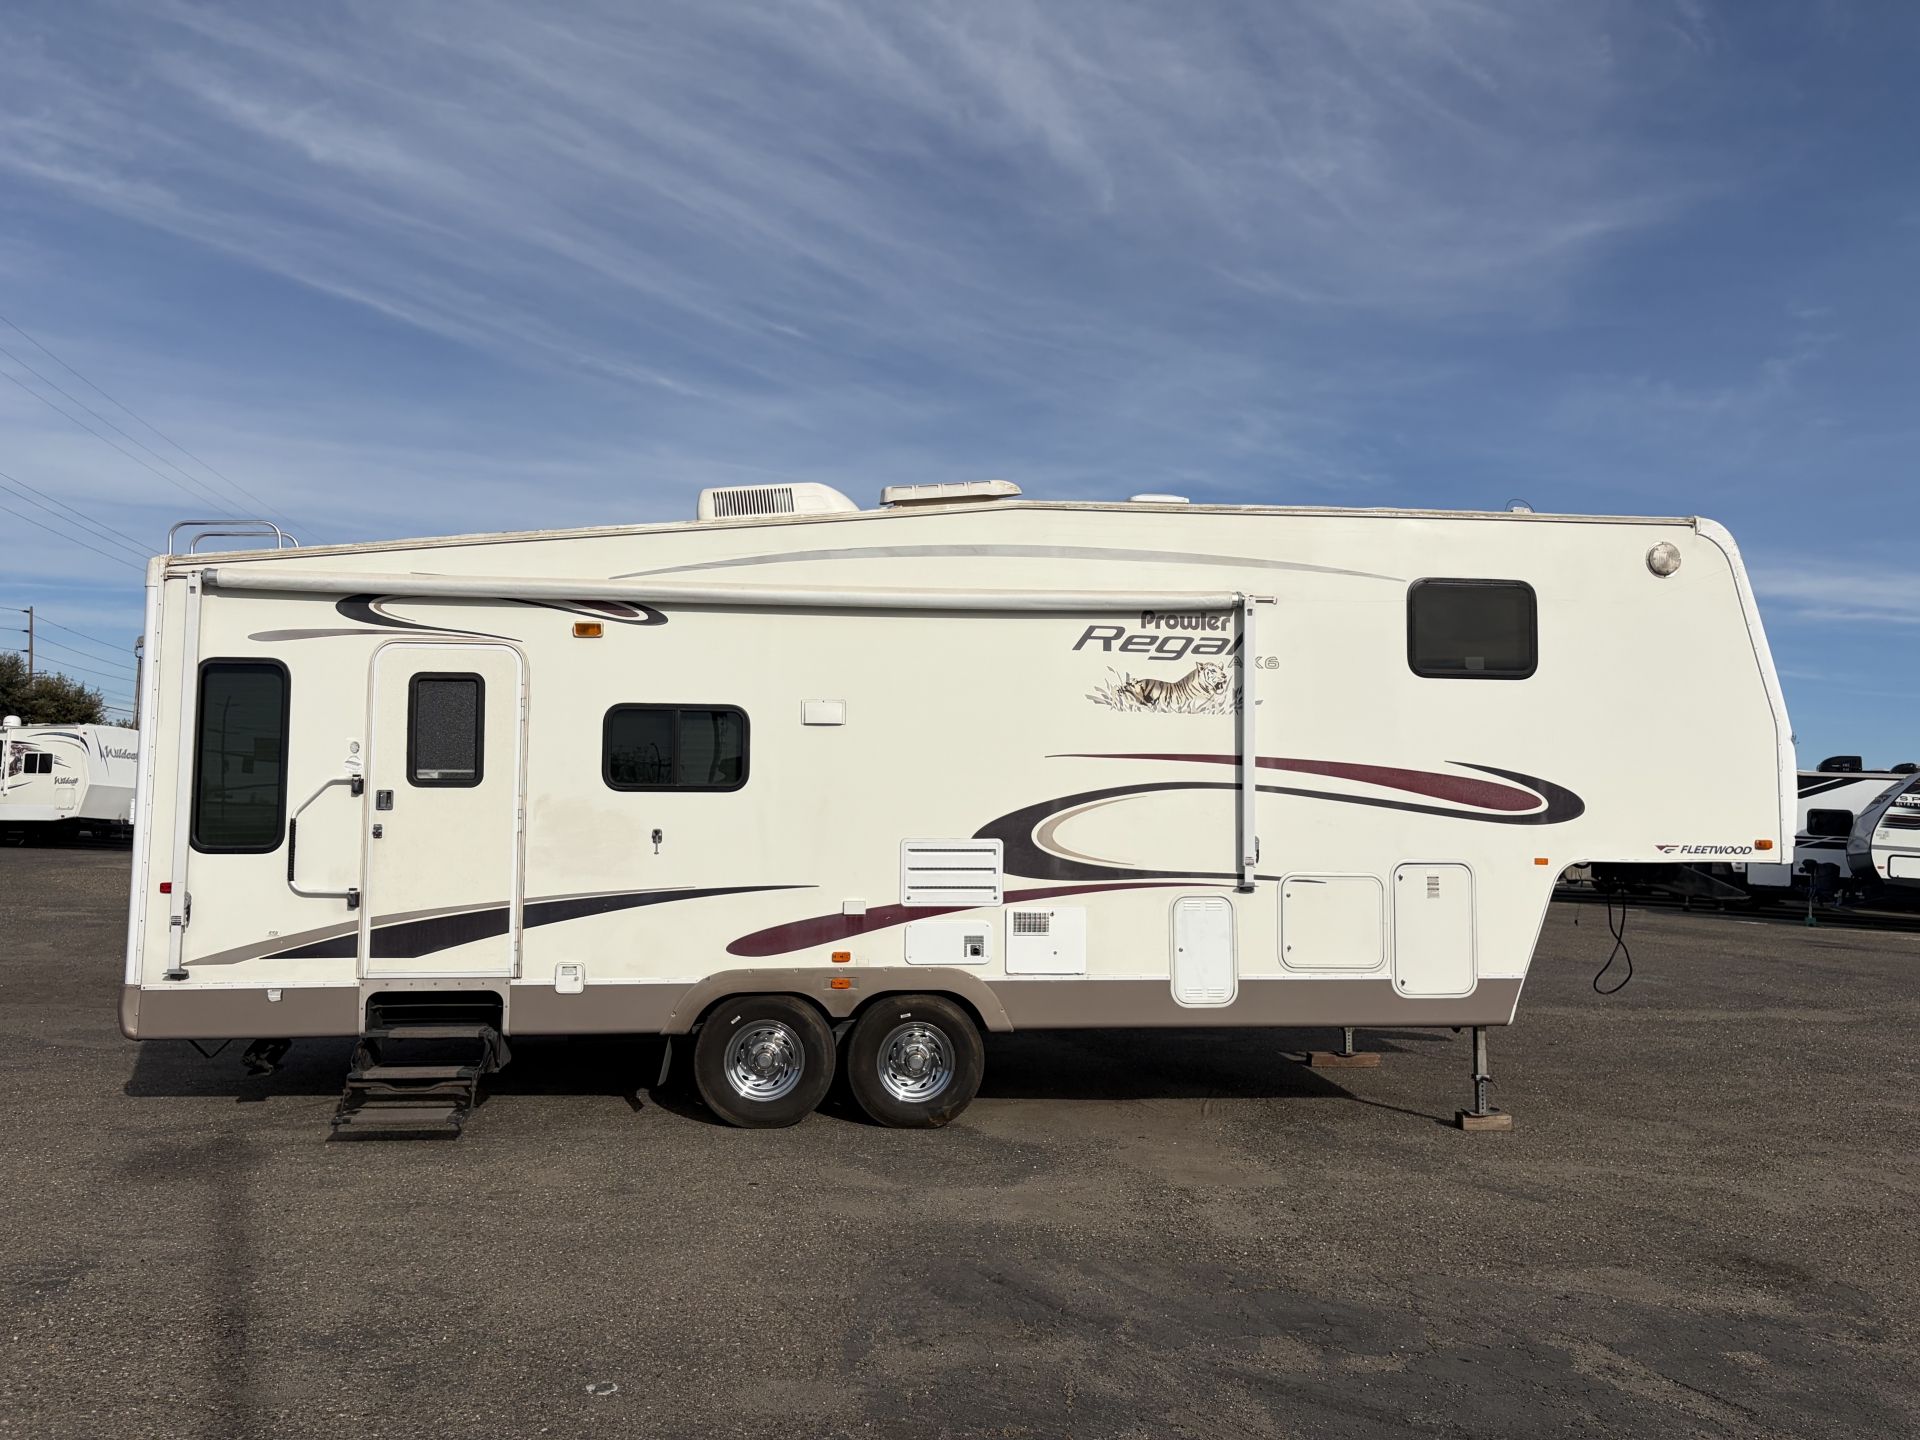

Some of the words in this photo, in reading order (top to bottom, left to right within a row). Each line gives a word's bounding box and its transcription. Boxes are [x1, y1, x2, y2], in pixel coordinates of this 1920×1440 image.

[1141, 610, 1231, 631] Prowler
[1072, 625, 1244, 660] Regal
[1680, 845, 1752, 855] FLEETWOOD
